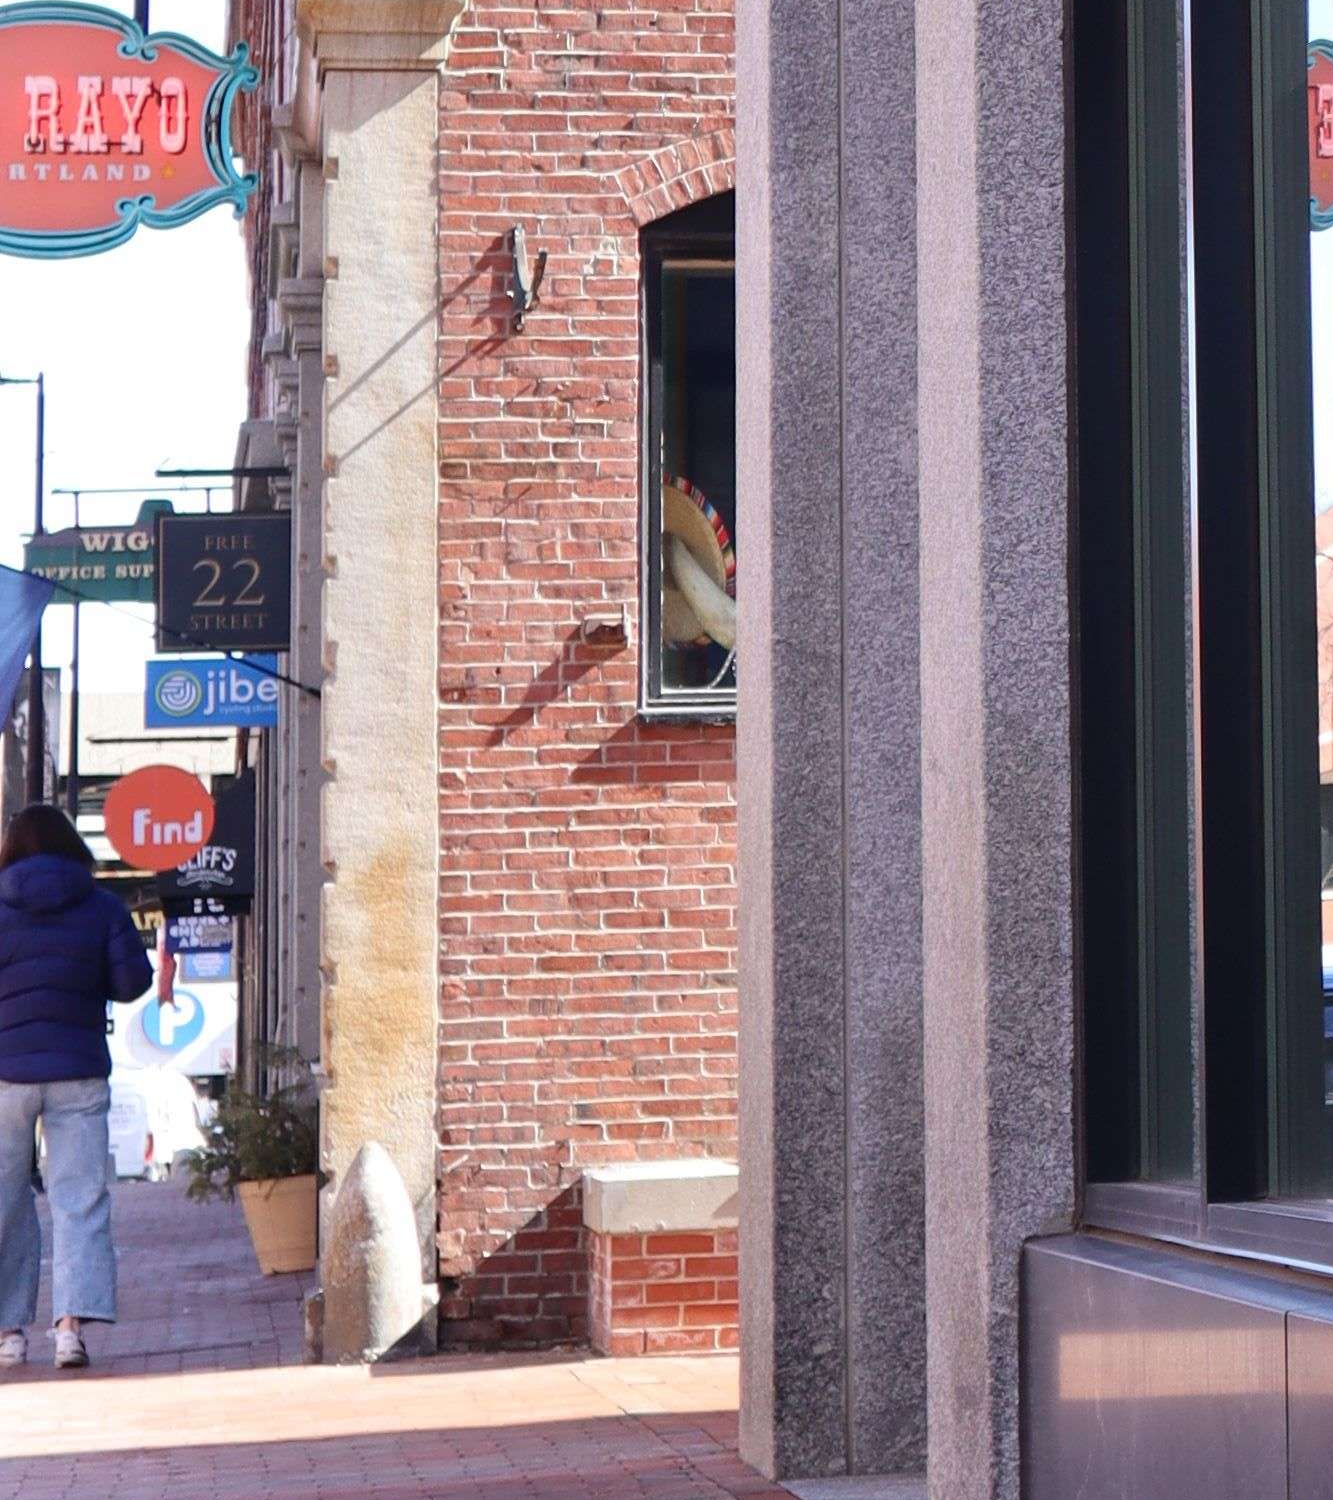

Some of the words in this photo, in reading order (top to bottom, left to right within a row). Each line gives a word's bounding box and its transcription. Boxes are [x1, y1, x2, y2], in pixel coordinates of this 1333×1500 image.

[24, 75, 188, 153] RAYO
[80, 531, 154, 553] WIG
[204, 535, 257, 550] FREE
[192, 559, 266, 607] 22
[190, 614, 268, 630] STREET
[203, 670, 278, 716] jibe
